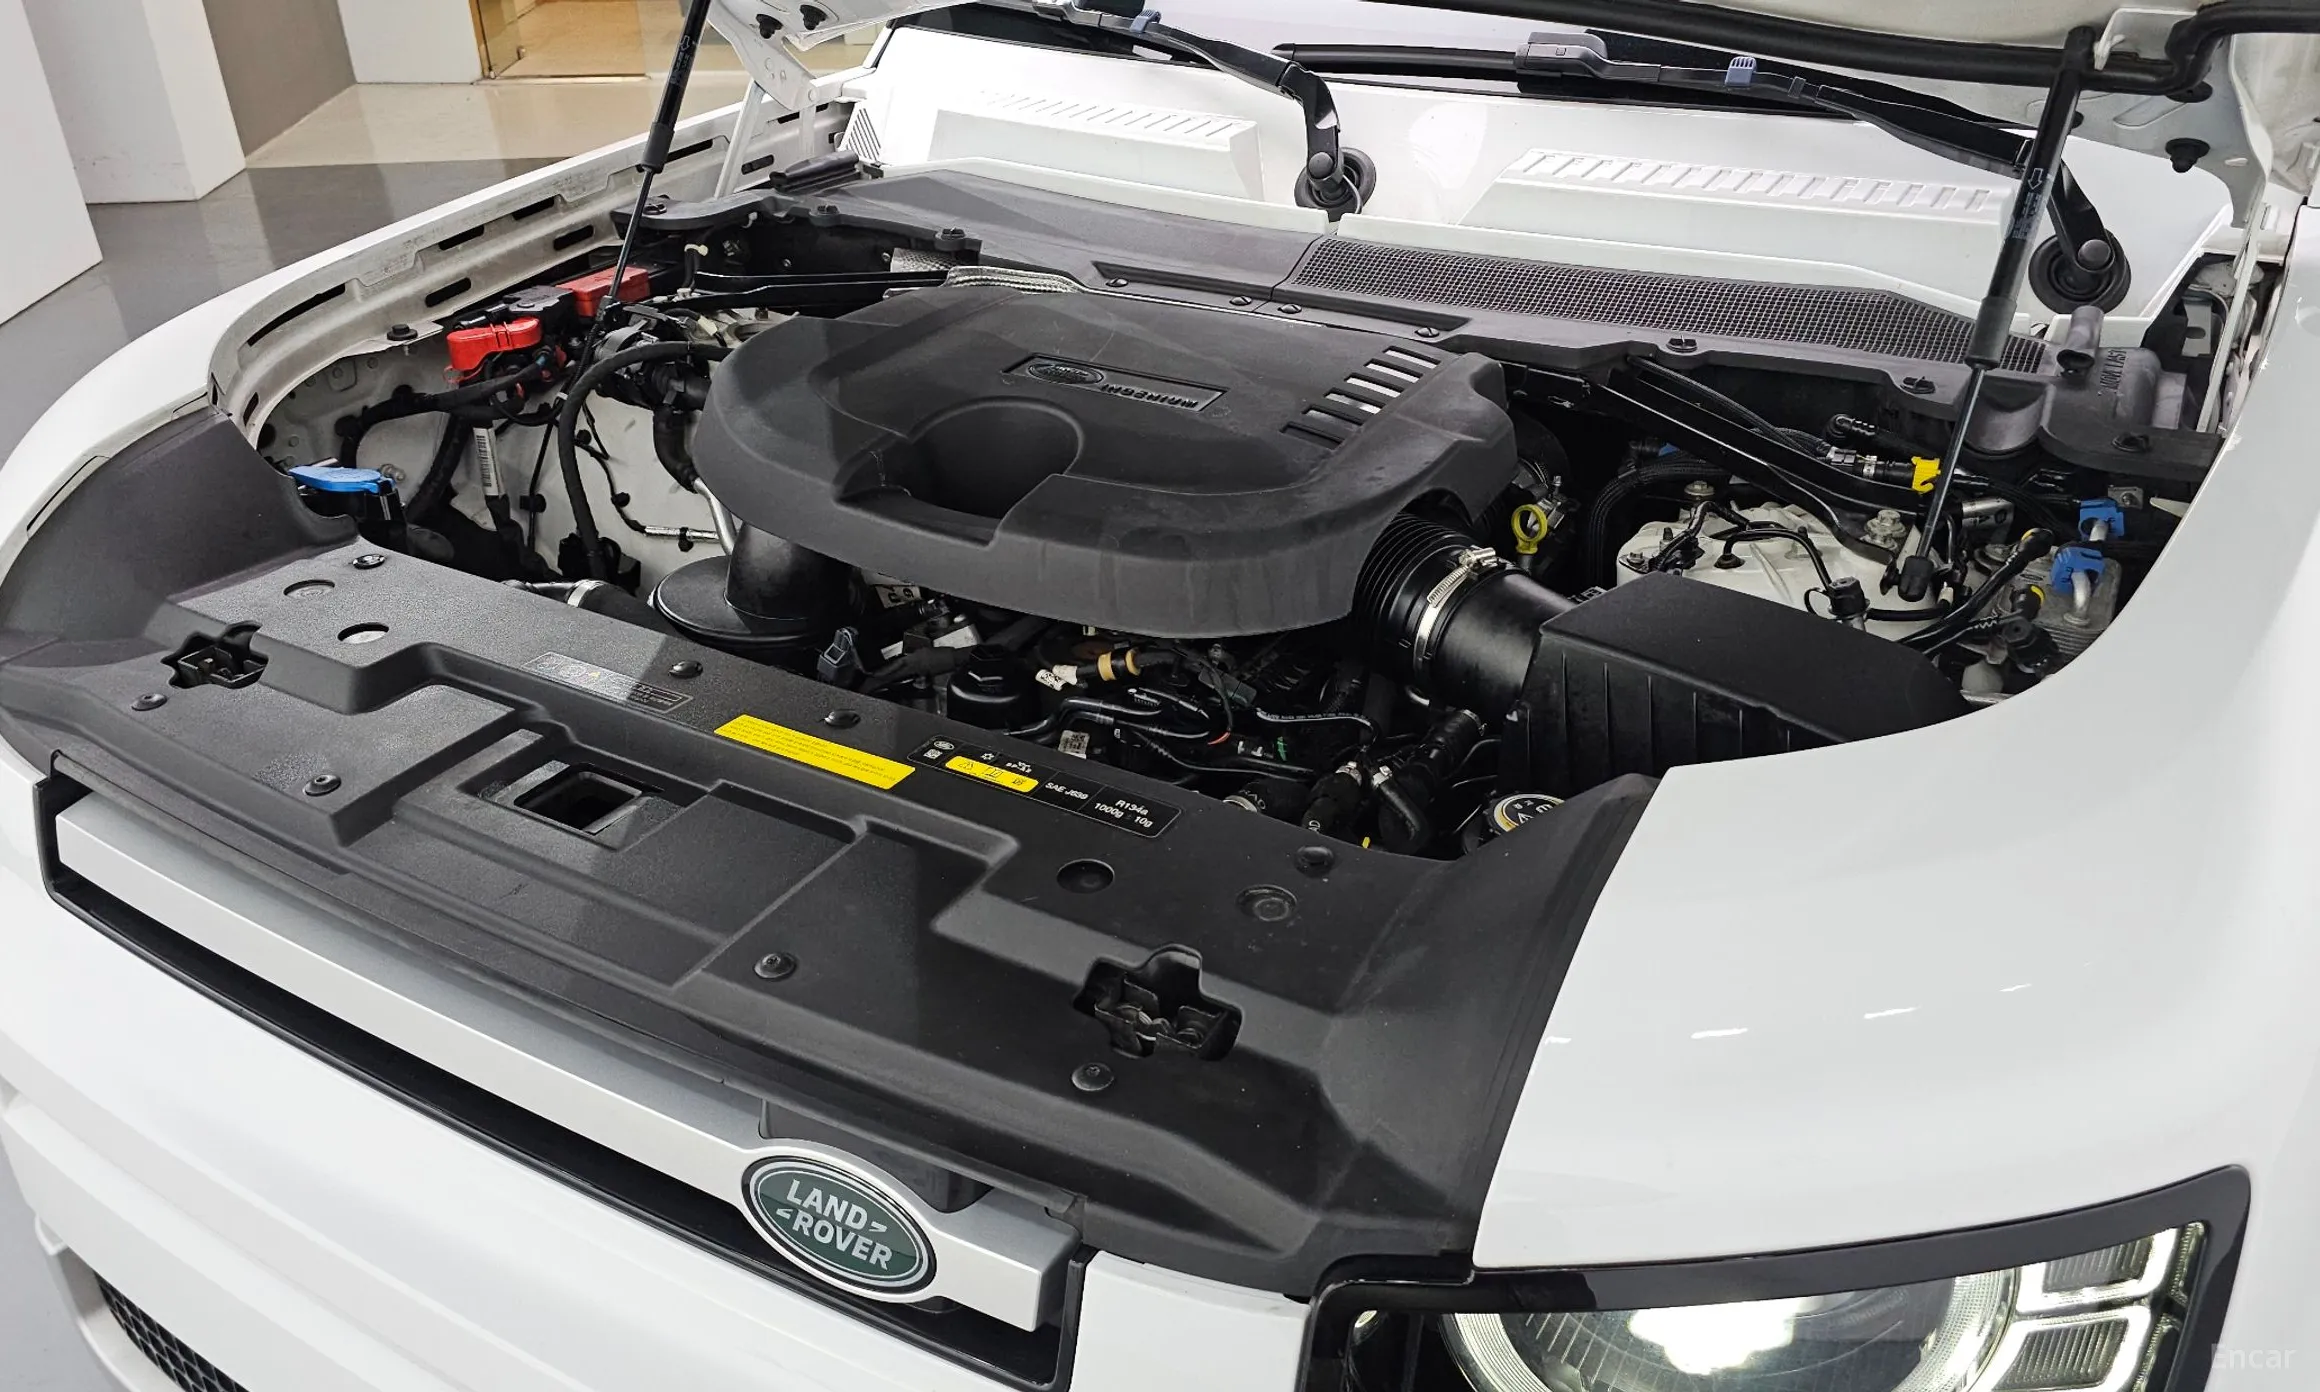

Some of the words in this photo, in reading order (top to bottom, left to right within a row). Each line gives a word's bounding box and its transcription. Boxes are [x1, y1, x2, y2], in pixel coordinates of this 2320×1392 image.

[1100, 384, 1198, 408] INGENIUM
[1045, 782, 1066, 793] SAE
[1065, 789, 1089, 800] J639
[1094, 802, 1125, 819] 1000g
[1134, 816, 1154, 828] 10g
[1115, 800, 1149, 816] R134a
[786, 1179, 868, 1230] LAND
[792, 1208, 893, 1271] ROVER
